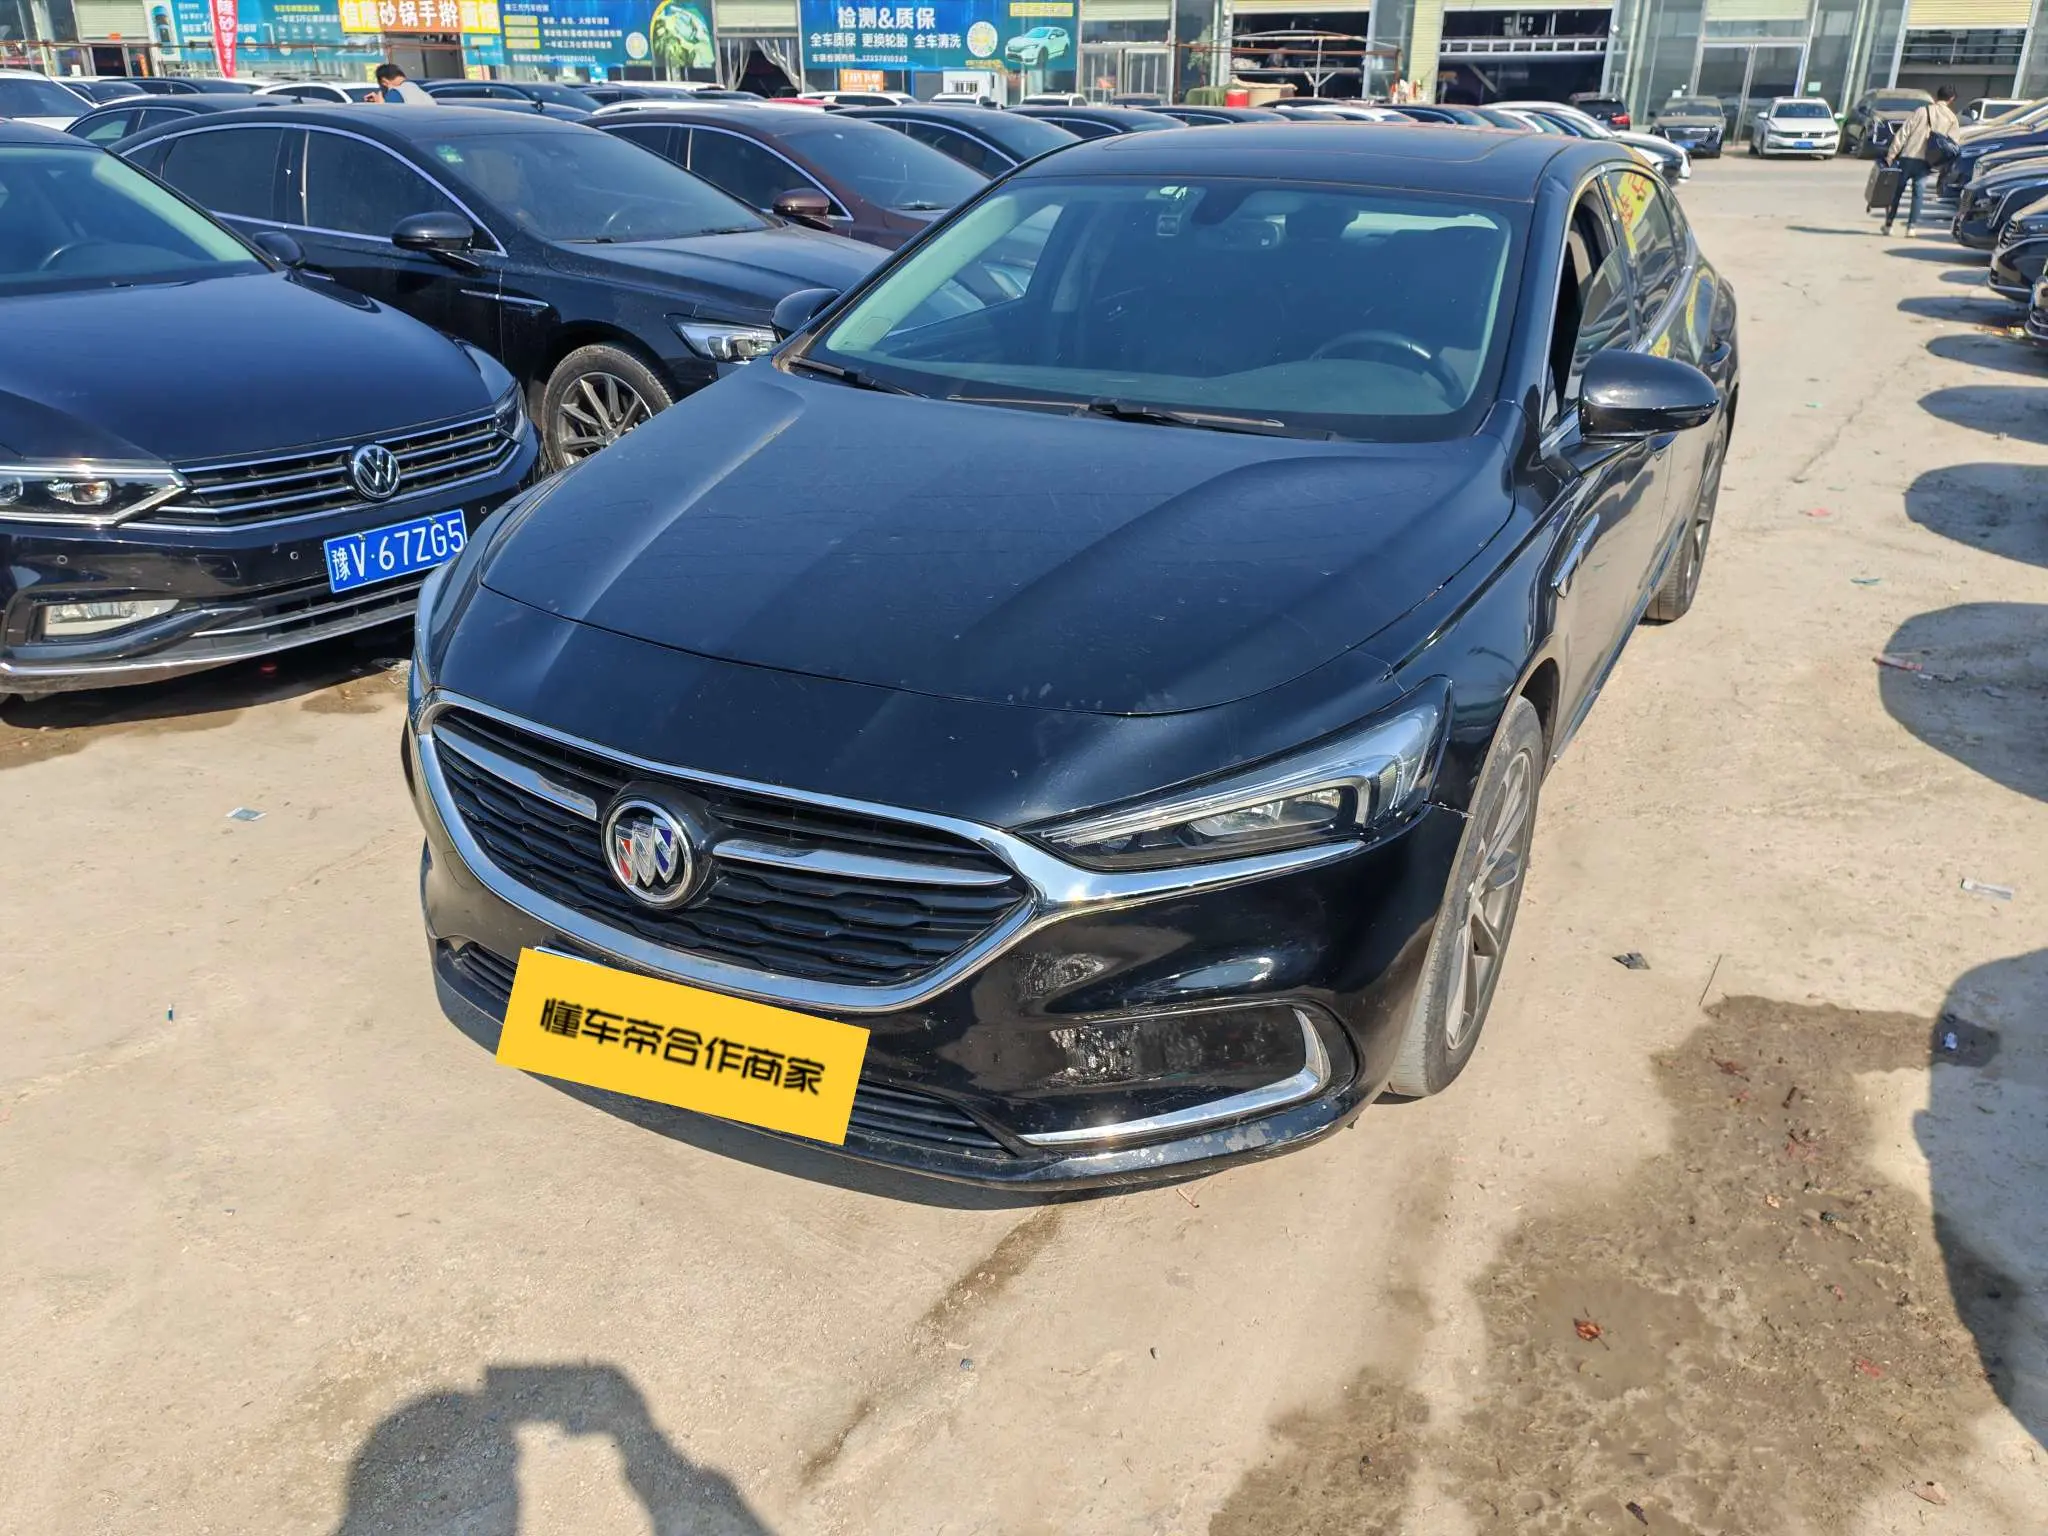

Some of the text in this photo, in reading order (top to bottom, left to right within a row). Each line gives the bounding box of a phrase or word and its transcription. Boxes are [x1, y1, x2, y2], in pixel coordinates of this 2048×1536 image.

[837, 6, 936, 29] 检测&质保
[810, 32, 961, 49] 全车质保 更换轮胎 全车清洗
